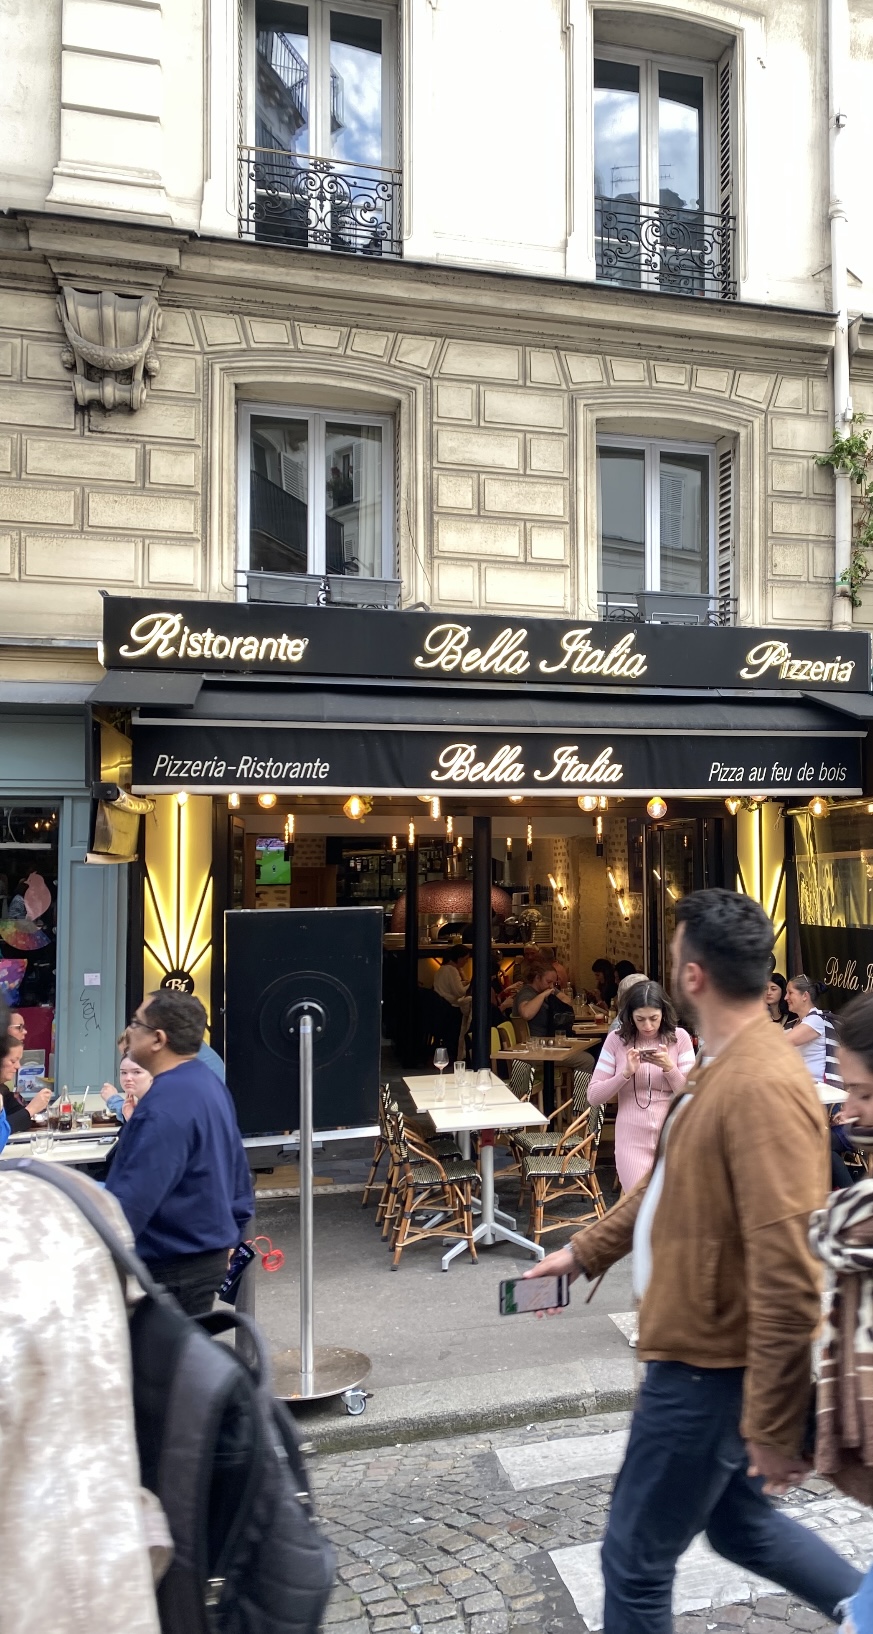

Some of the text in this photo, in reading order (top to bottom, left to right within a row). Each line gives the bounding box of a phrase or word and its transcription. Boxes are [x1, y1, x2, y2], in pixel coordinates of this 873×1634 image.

[119, 612, 309, 662] Ristorante
[414, 623, 648, 679] Bella Italia
[740, 640, 855, 683] Pizzeria
[152, 754, 330, 780] Pizzeria-Ristorante
[430, 743, 624, 784] Bella Italia
[708, 762, 847, 783] Pizza au feu de bois
[824, 956, 860, 991] Bella
